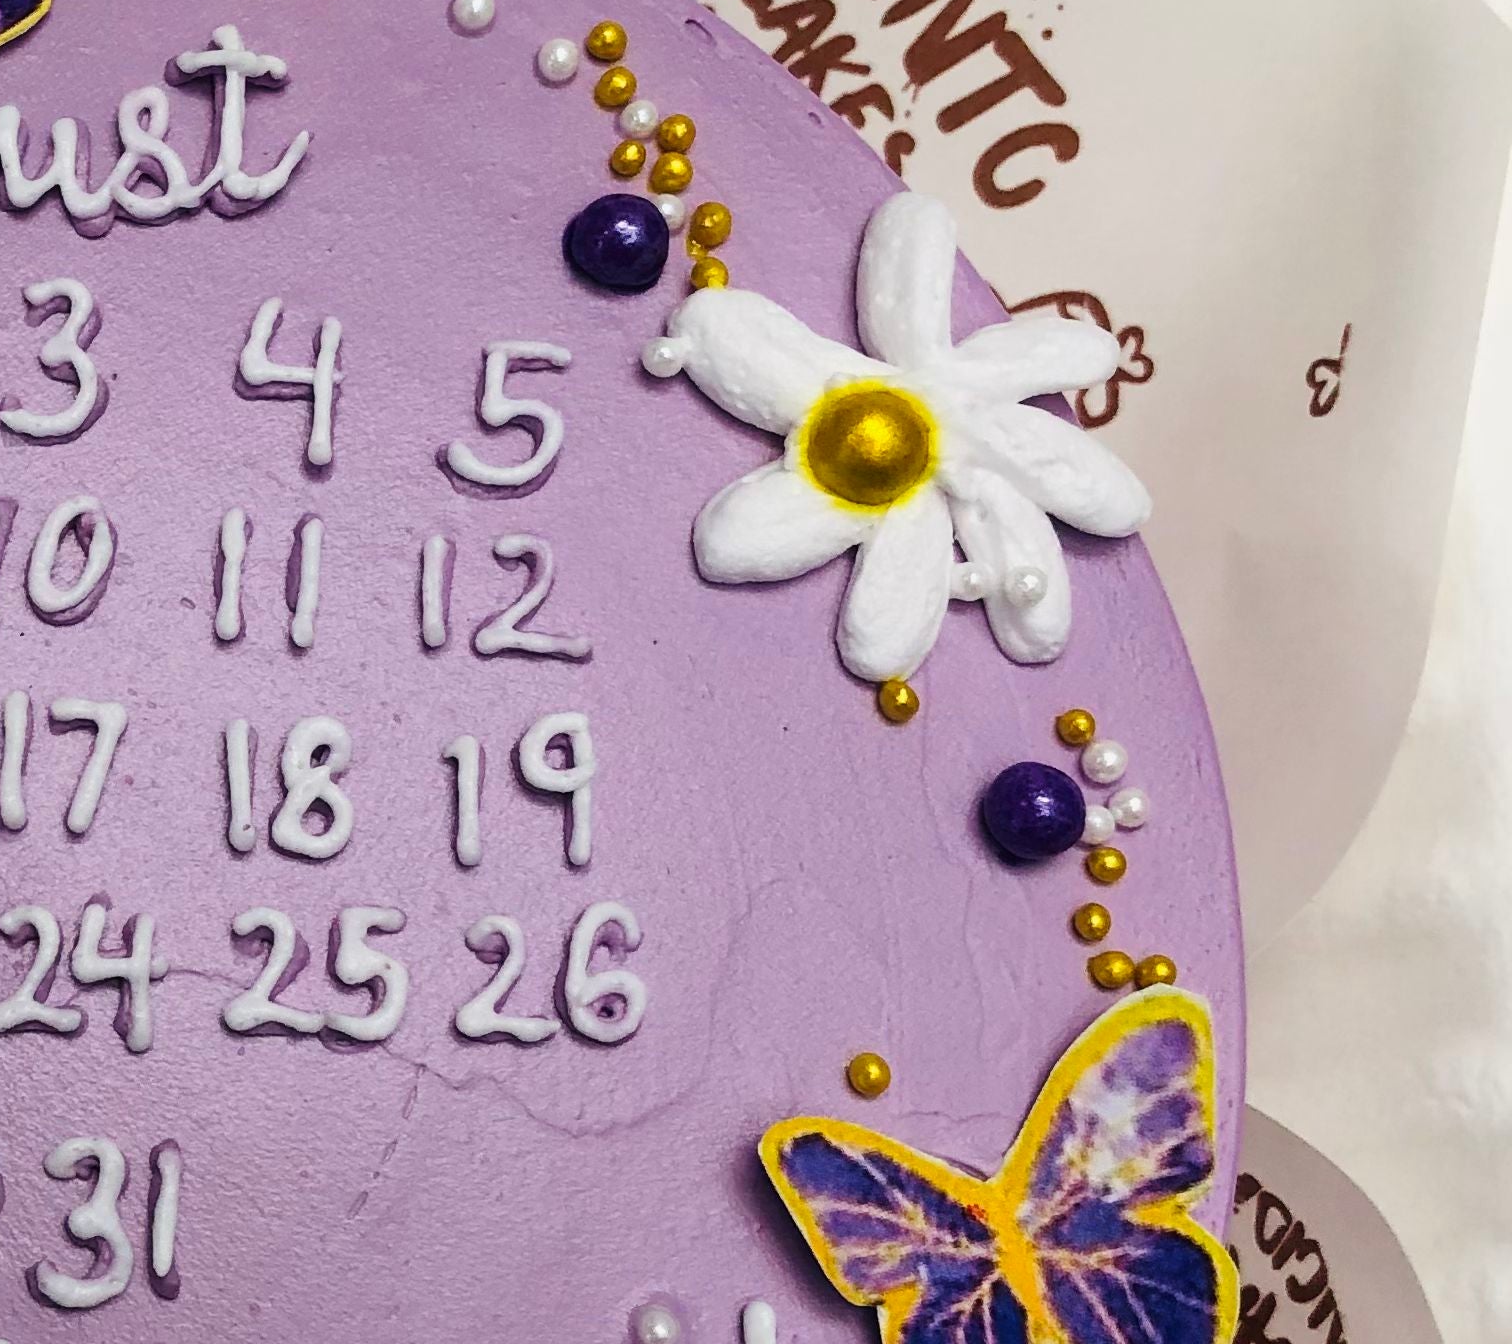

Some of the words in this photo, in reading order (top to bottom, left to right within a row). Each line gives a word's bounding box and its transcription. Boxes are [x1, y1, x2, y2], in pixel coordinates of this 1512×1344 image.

[0, 278, 98, 438] 3
[239, 297, 341, 467] 4
[444, 342, 571, 487] 5
[216, 507, 323, 647] 11
[422, 533, 591, 657] 12
[0, 691, 127, 834] 17
[227, 715, 352, 859] 18
[443, 711, 593, 866] 19
[223, 905, 409, 1042] 25
[455, 902, 645, 1044] 26
[36, 1137, 181, 1308] 31
